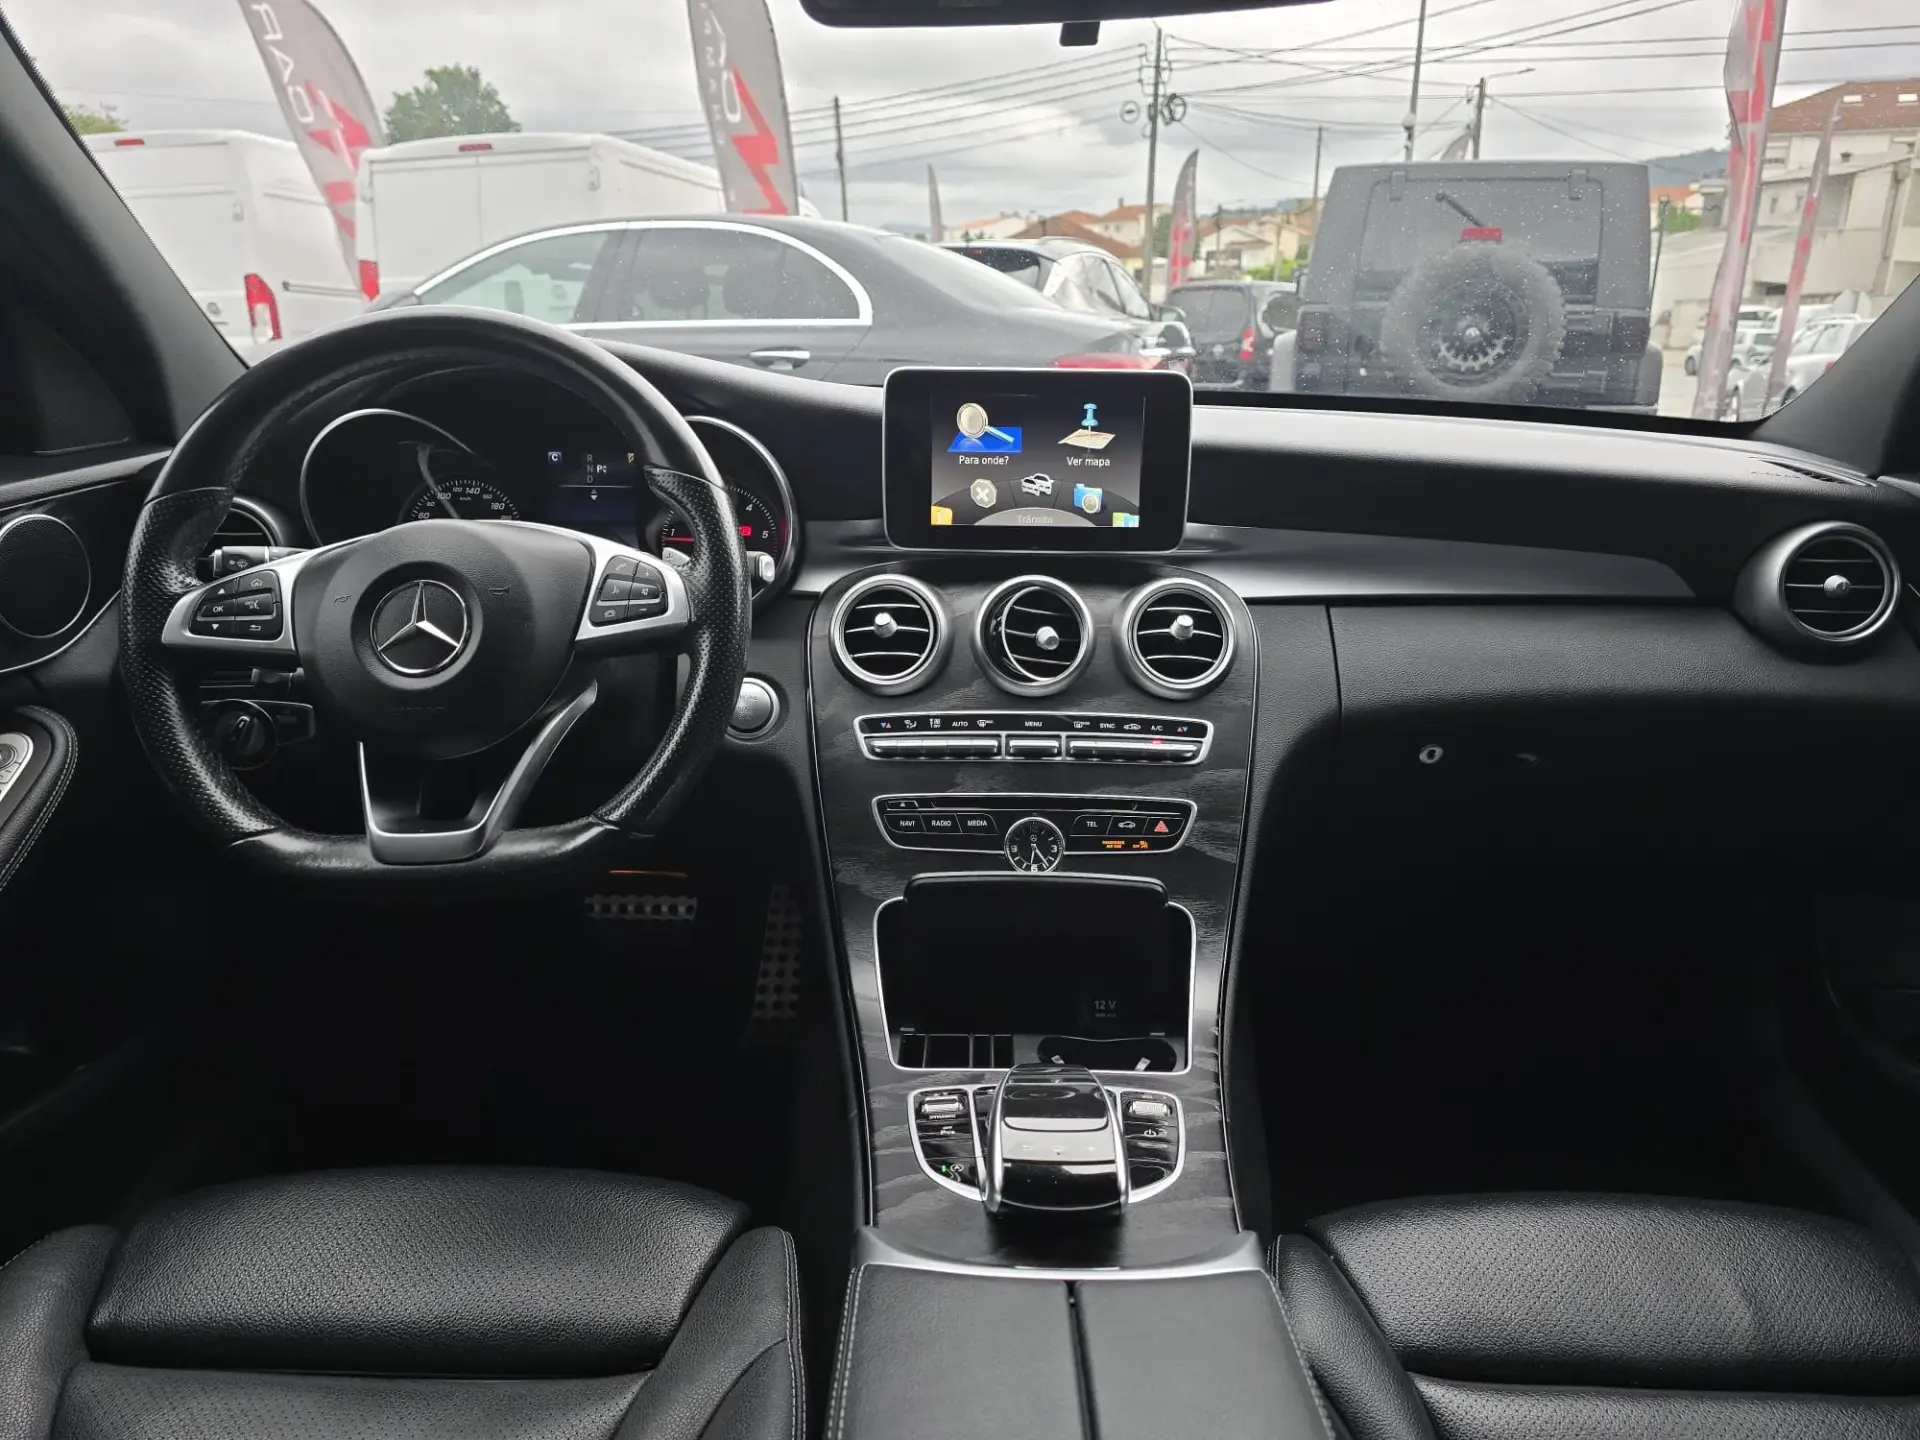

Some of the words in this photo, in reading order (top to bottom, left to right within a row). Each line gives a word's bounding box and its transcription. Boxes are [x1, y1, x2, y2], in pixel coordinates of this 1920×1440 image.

[586, 454, 593, 462] R
[959, 455, 979, 465] Para
[982, 455, 1009, 465] onde?
[1067, 456, 1083, 466] Ver
[1085, 458, 1110, 468] mapa
[437, 492, 452, 500] 100
[490, 502, 506, 510] 180
[418, 512, 430, 520] 60
[761, 530, 769, 539] 5
[212, 605, 224, 613] OK
[1051, 845, 1058, 853] 3
[1094, 1000, 1106, 1010] 12
[1108, 1000, 1117, 1010] V
